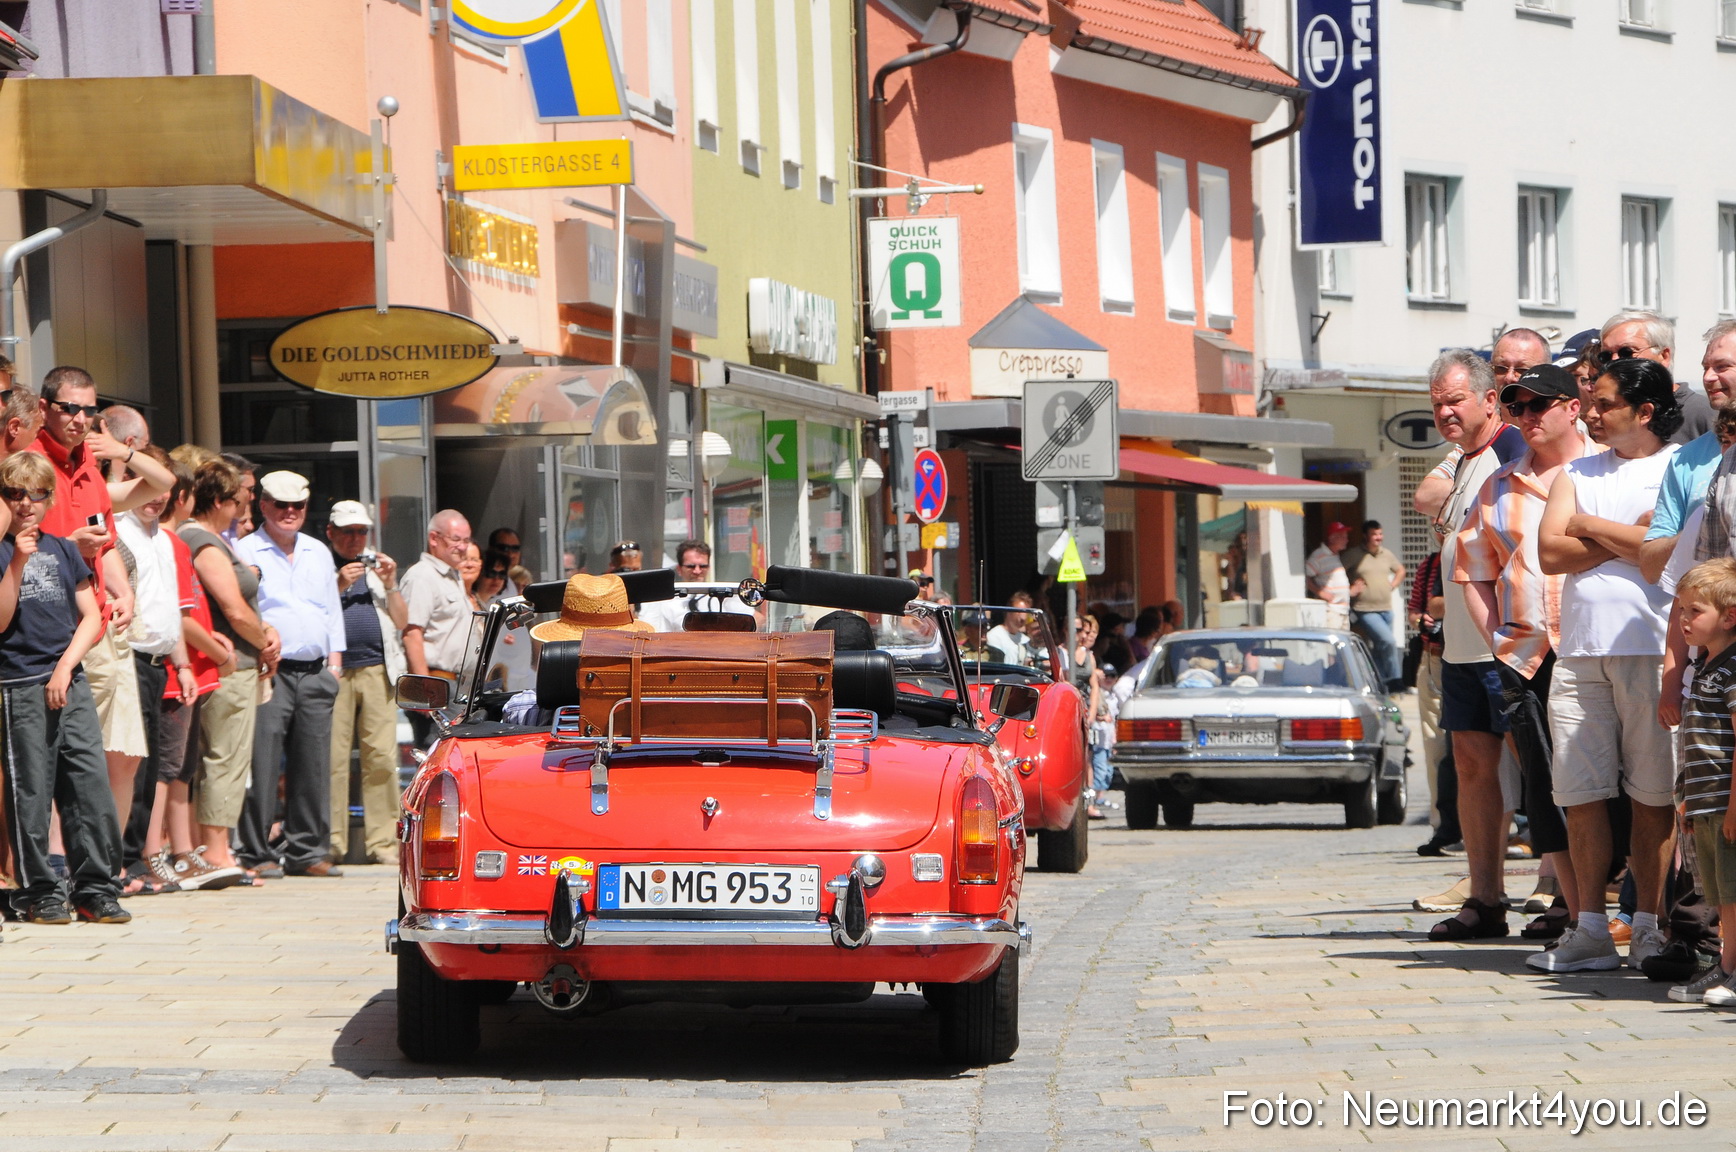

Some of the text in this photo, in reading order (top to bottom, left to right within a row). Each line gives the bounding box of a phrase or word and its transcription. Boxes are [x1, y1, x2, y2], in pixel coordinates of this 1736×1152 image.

[1351, 0, 1375, 211] TOM TA
[463, 152, 621, 177] KLOSTERGASSE 4
[889, 225, 938, 239] QUICK
[888, 239, 942, 251] SCHUH
[889, 251, 943, 321] Q
[281, 344, 490, 363] DIE GOLDSCHMIEDE
[998, 350, 1083, 379] Creppresso
[338, 370, 430, 383] JUTTA ROTHER
[1047, 453, 1092, 470] ZONE
[800, 873, 814, 883] 04
[624, 871, 792, 904] N MG 953
[605, 891, 614, 902] D
[801, 895, 814, 905] 10
